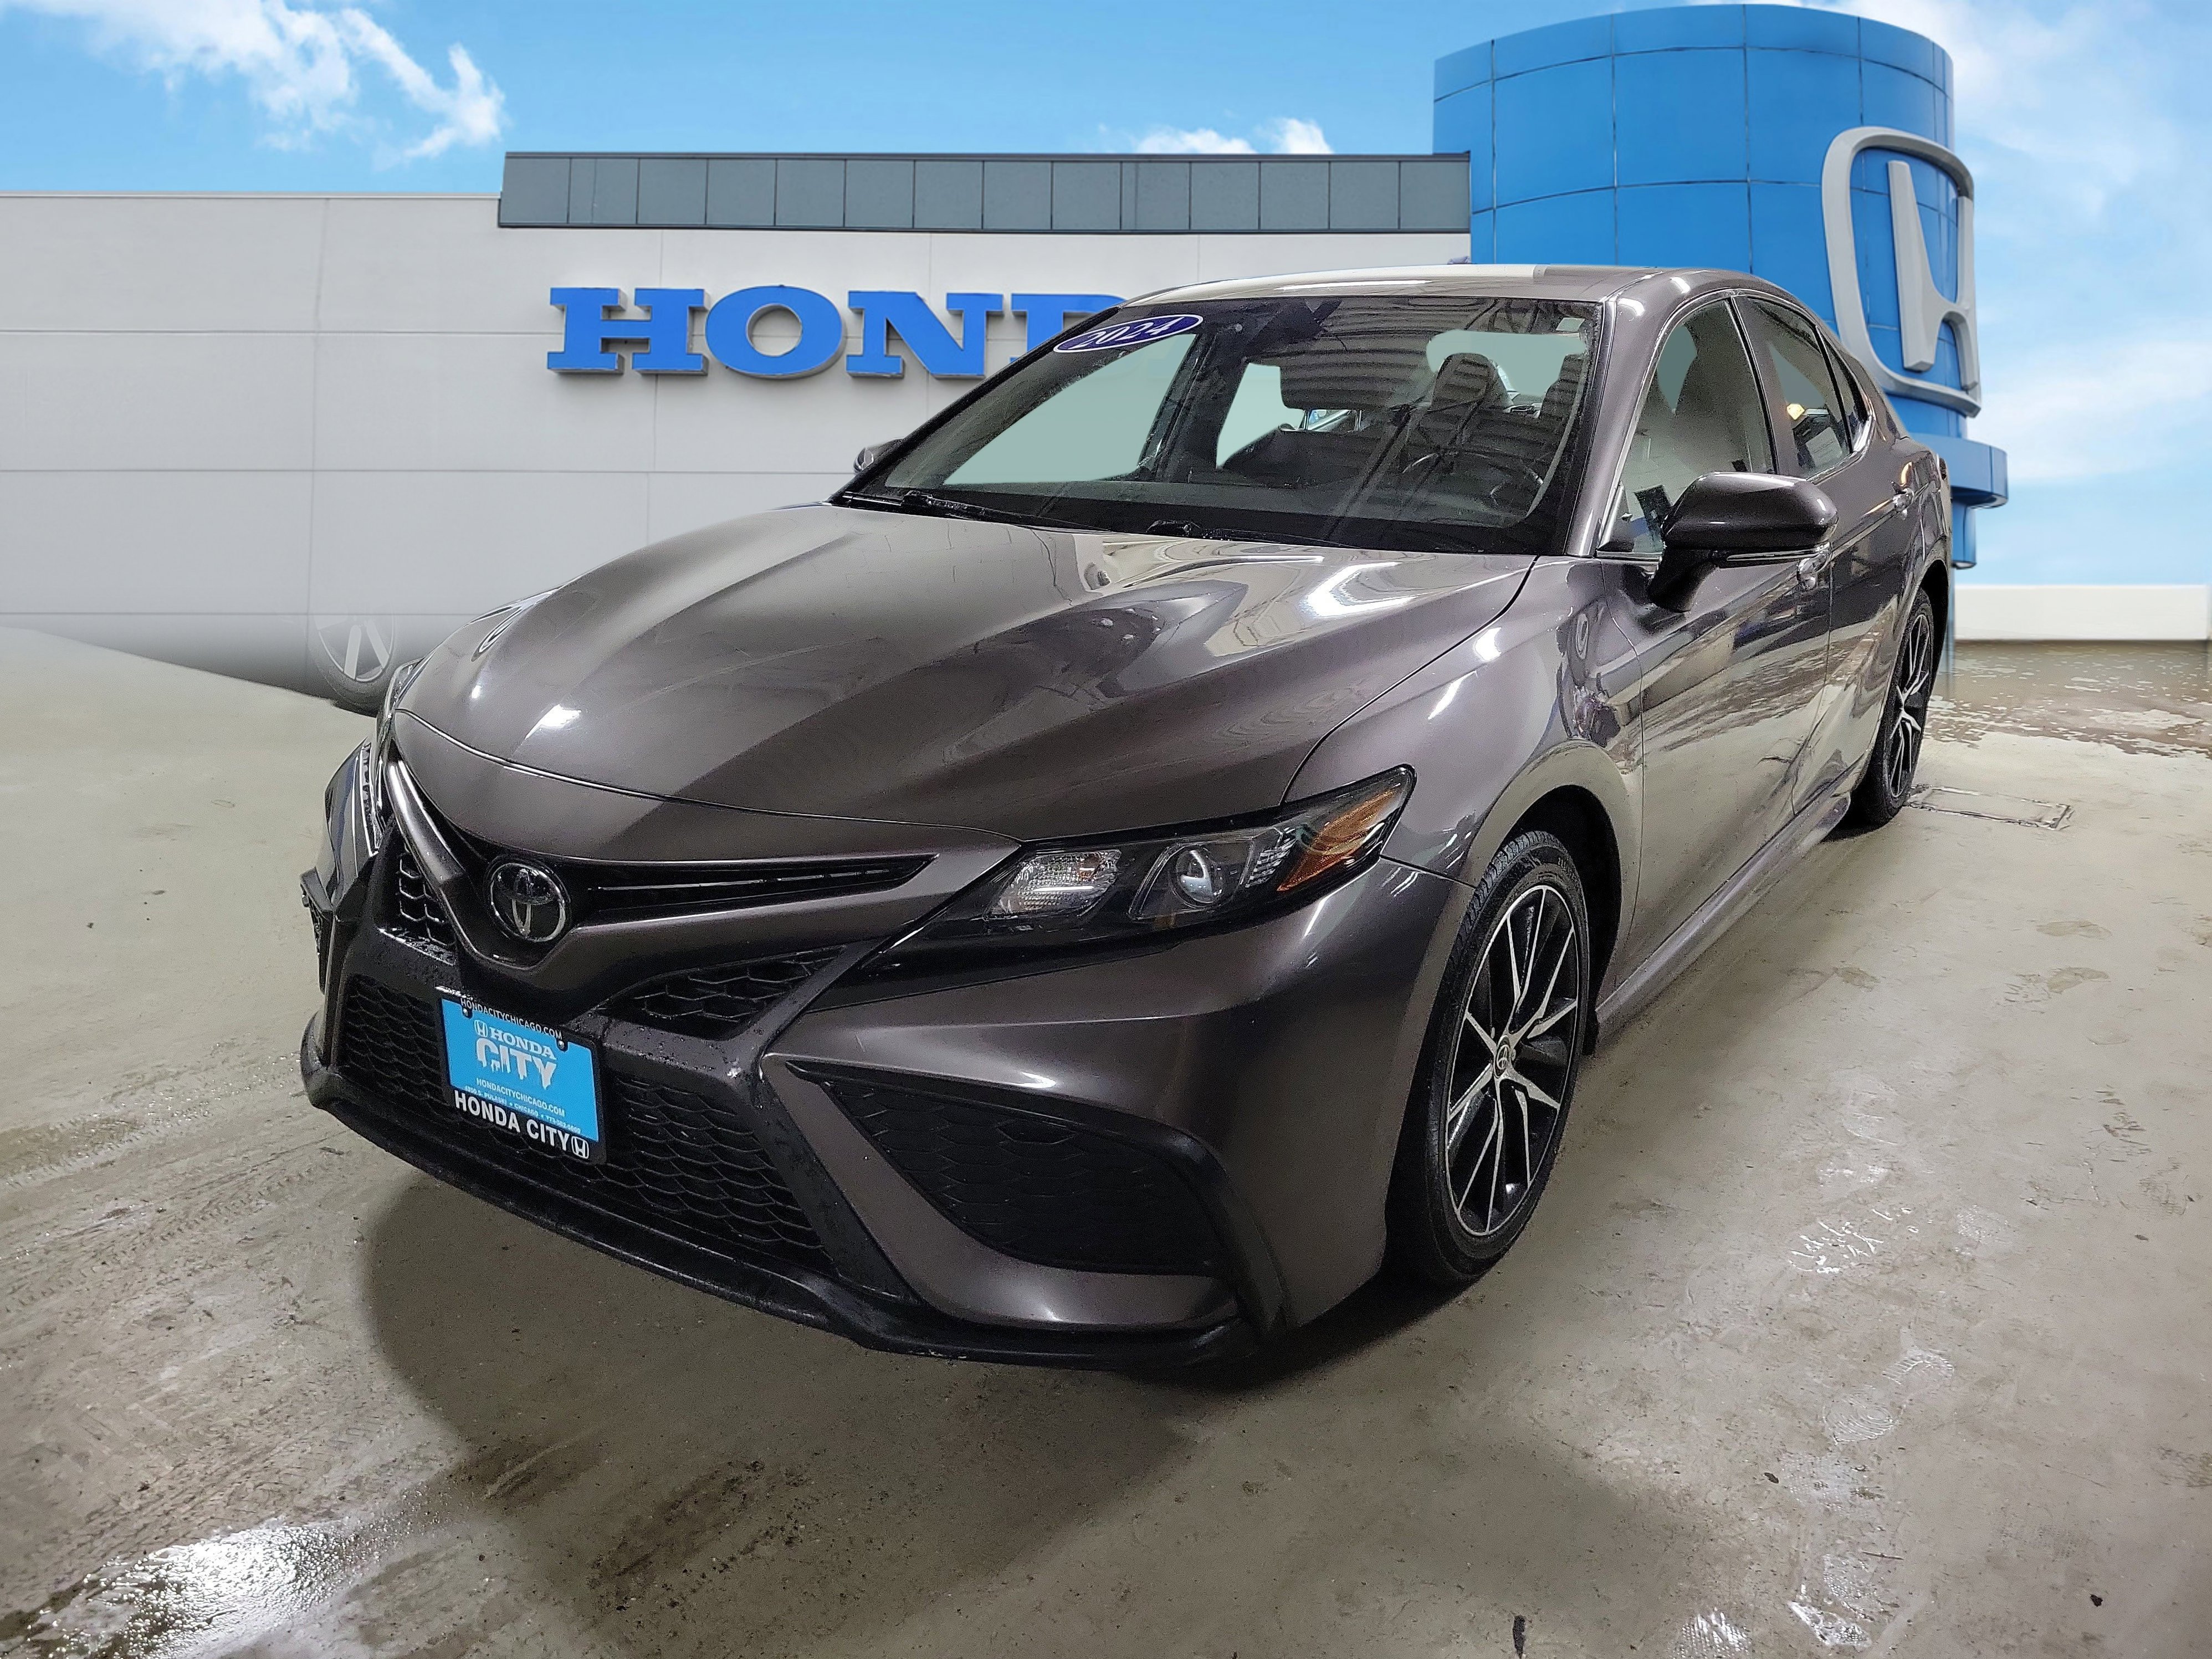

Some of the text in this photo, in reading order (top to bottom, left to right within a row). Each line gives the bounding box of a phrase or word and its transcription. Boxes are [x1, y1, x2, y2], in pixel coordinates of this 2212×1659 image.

[1067, 317, 1185, 350] 2024
[460, 997, 562, 1040] HONDACITYCHICAGO.COM
[476, 1037, 557, 1090] CITY
[489, 1026, 557, 1061] HONDA
[476, 1077, 565, 1117] HONDACITYCHICAGO.COM
[454, 1089, 521, 1133] HONDA
[526, 1119, 570, 1151] CITY
